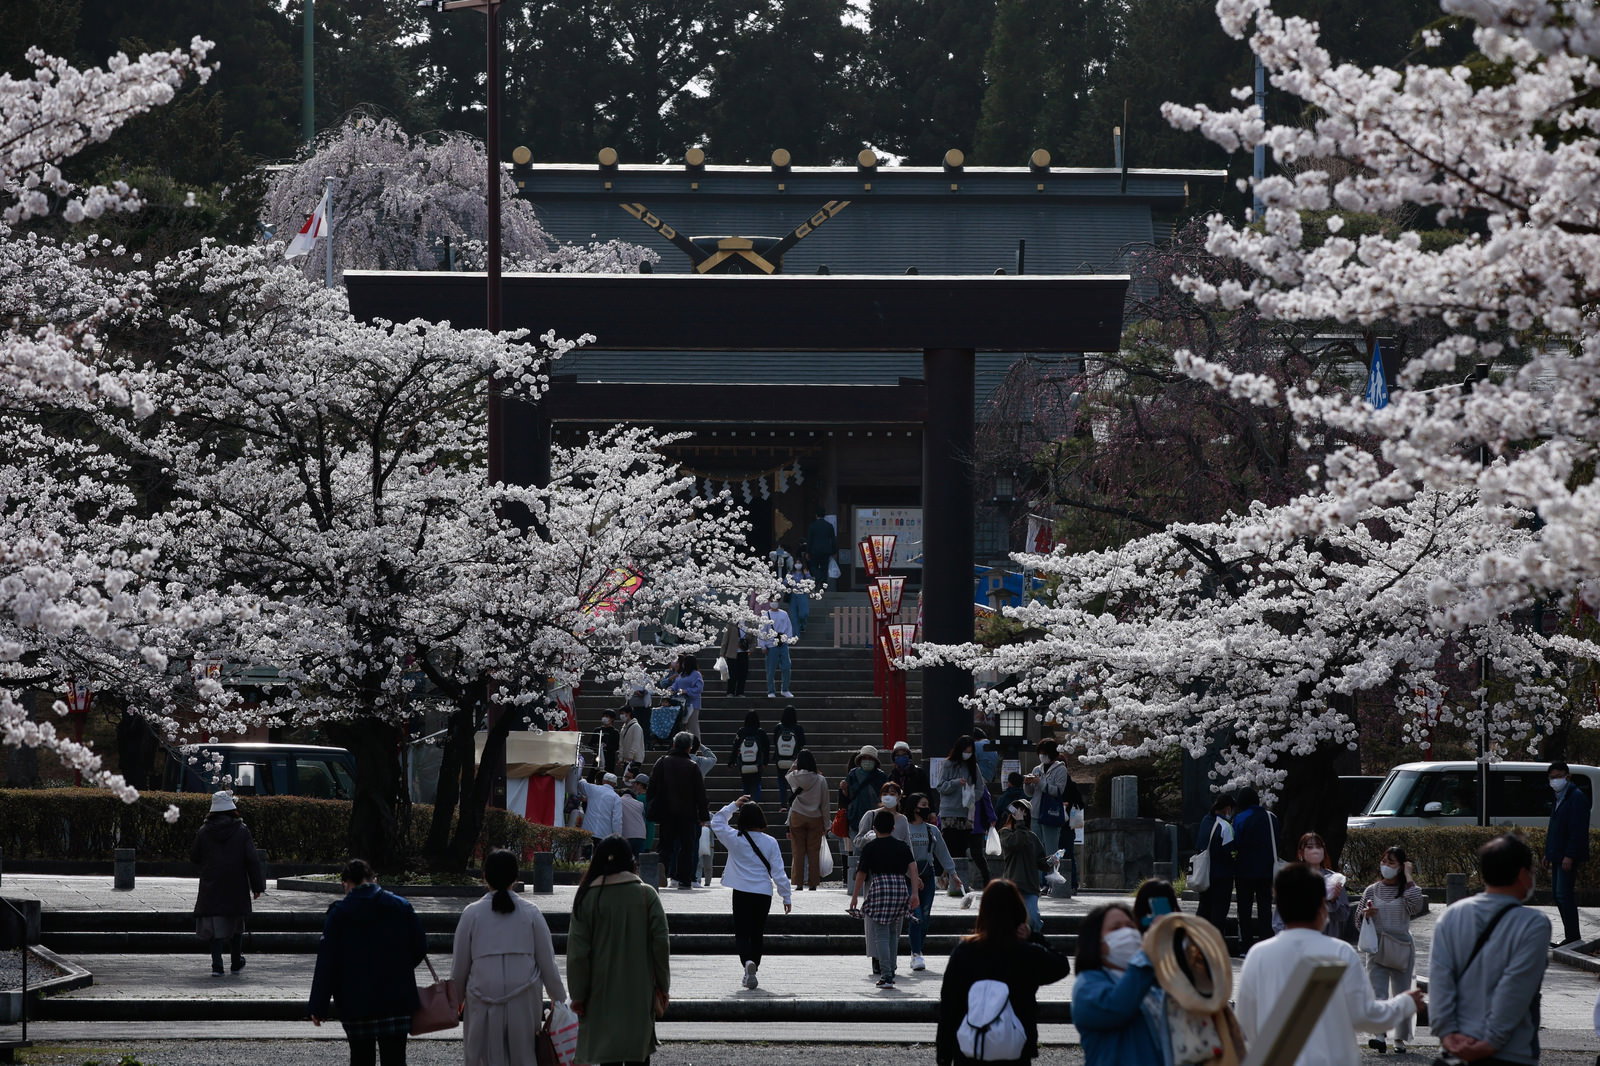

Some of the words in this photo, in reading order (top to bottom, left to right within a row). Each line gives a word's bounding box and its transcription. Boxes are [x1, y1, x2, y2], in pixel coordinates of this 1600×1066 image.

[881, 582, 891, 609] 桜まつり
[892, 628, 903, 658] 桜まつり
